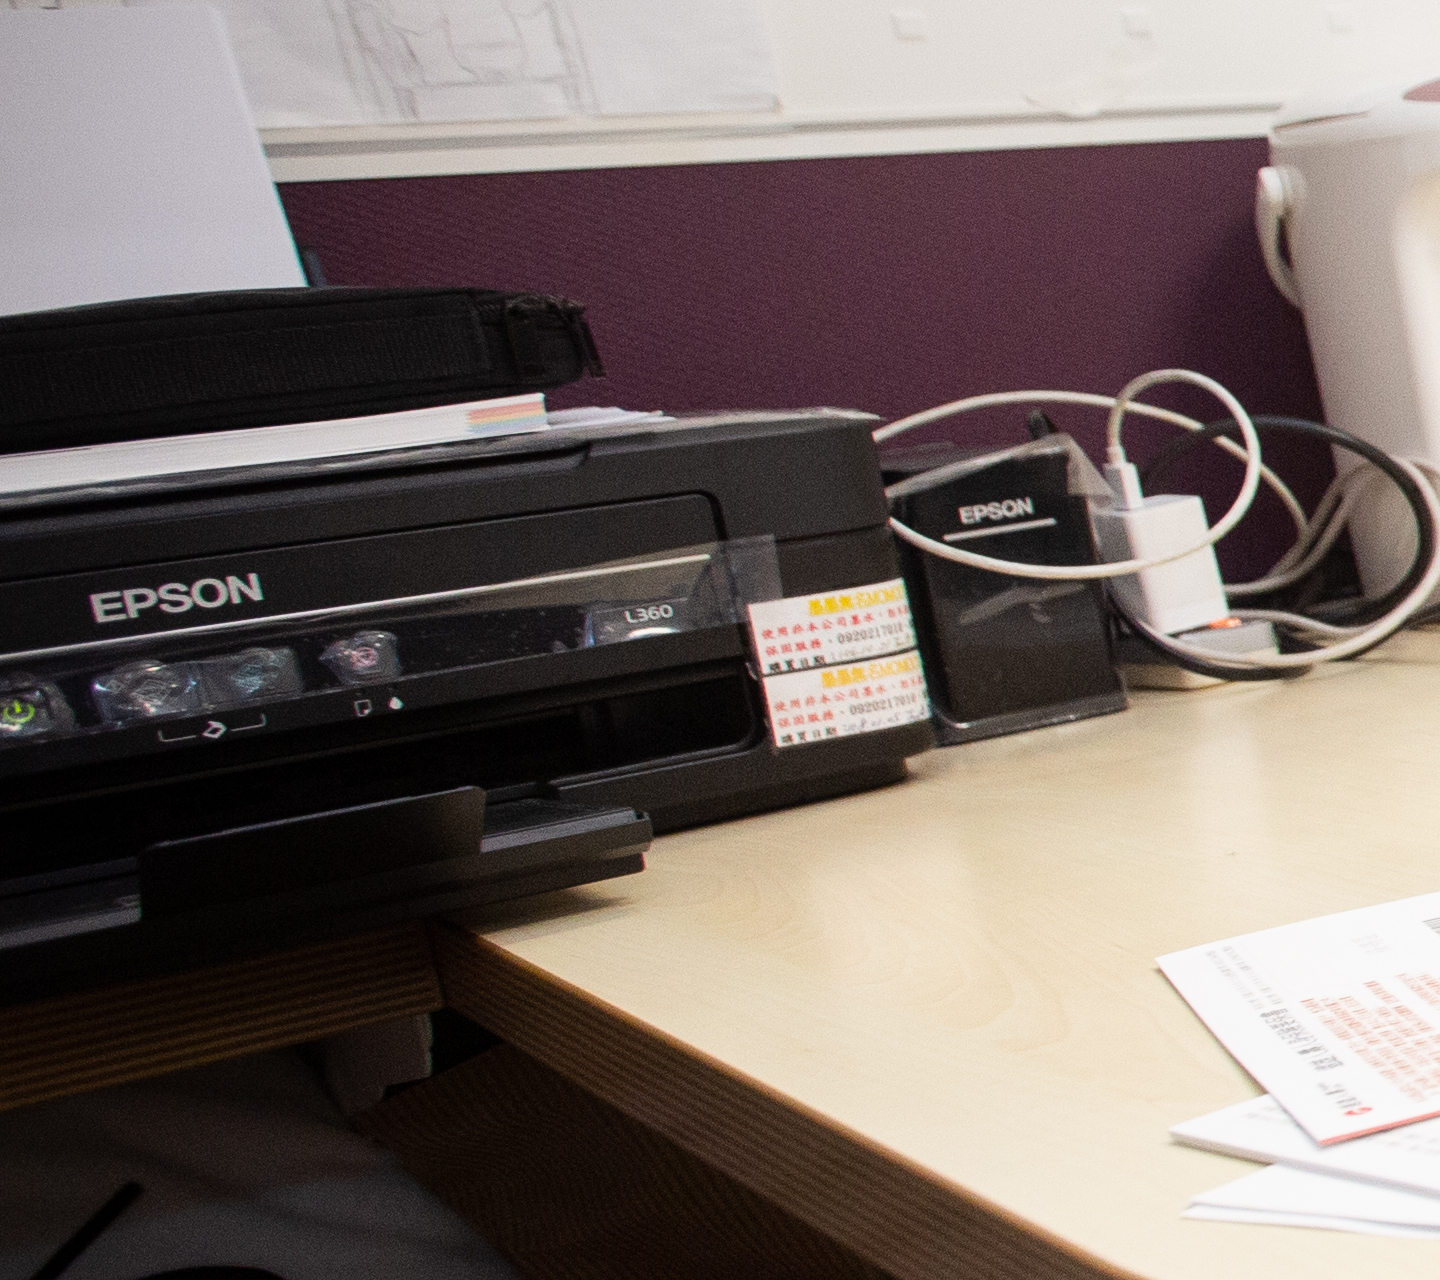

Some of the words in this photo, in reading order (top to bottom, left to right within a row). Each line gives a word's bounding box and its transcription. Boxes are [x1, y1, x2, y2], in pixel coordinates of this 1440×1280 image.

[957, 496, 1035, 525] EPSON
[89, 572, 265, 624] EPSON
[624, 603, 675, 624] L360
